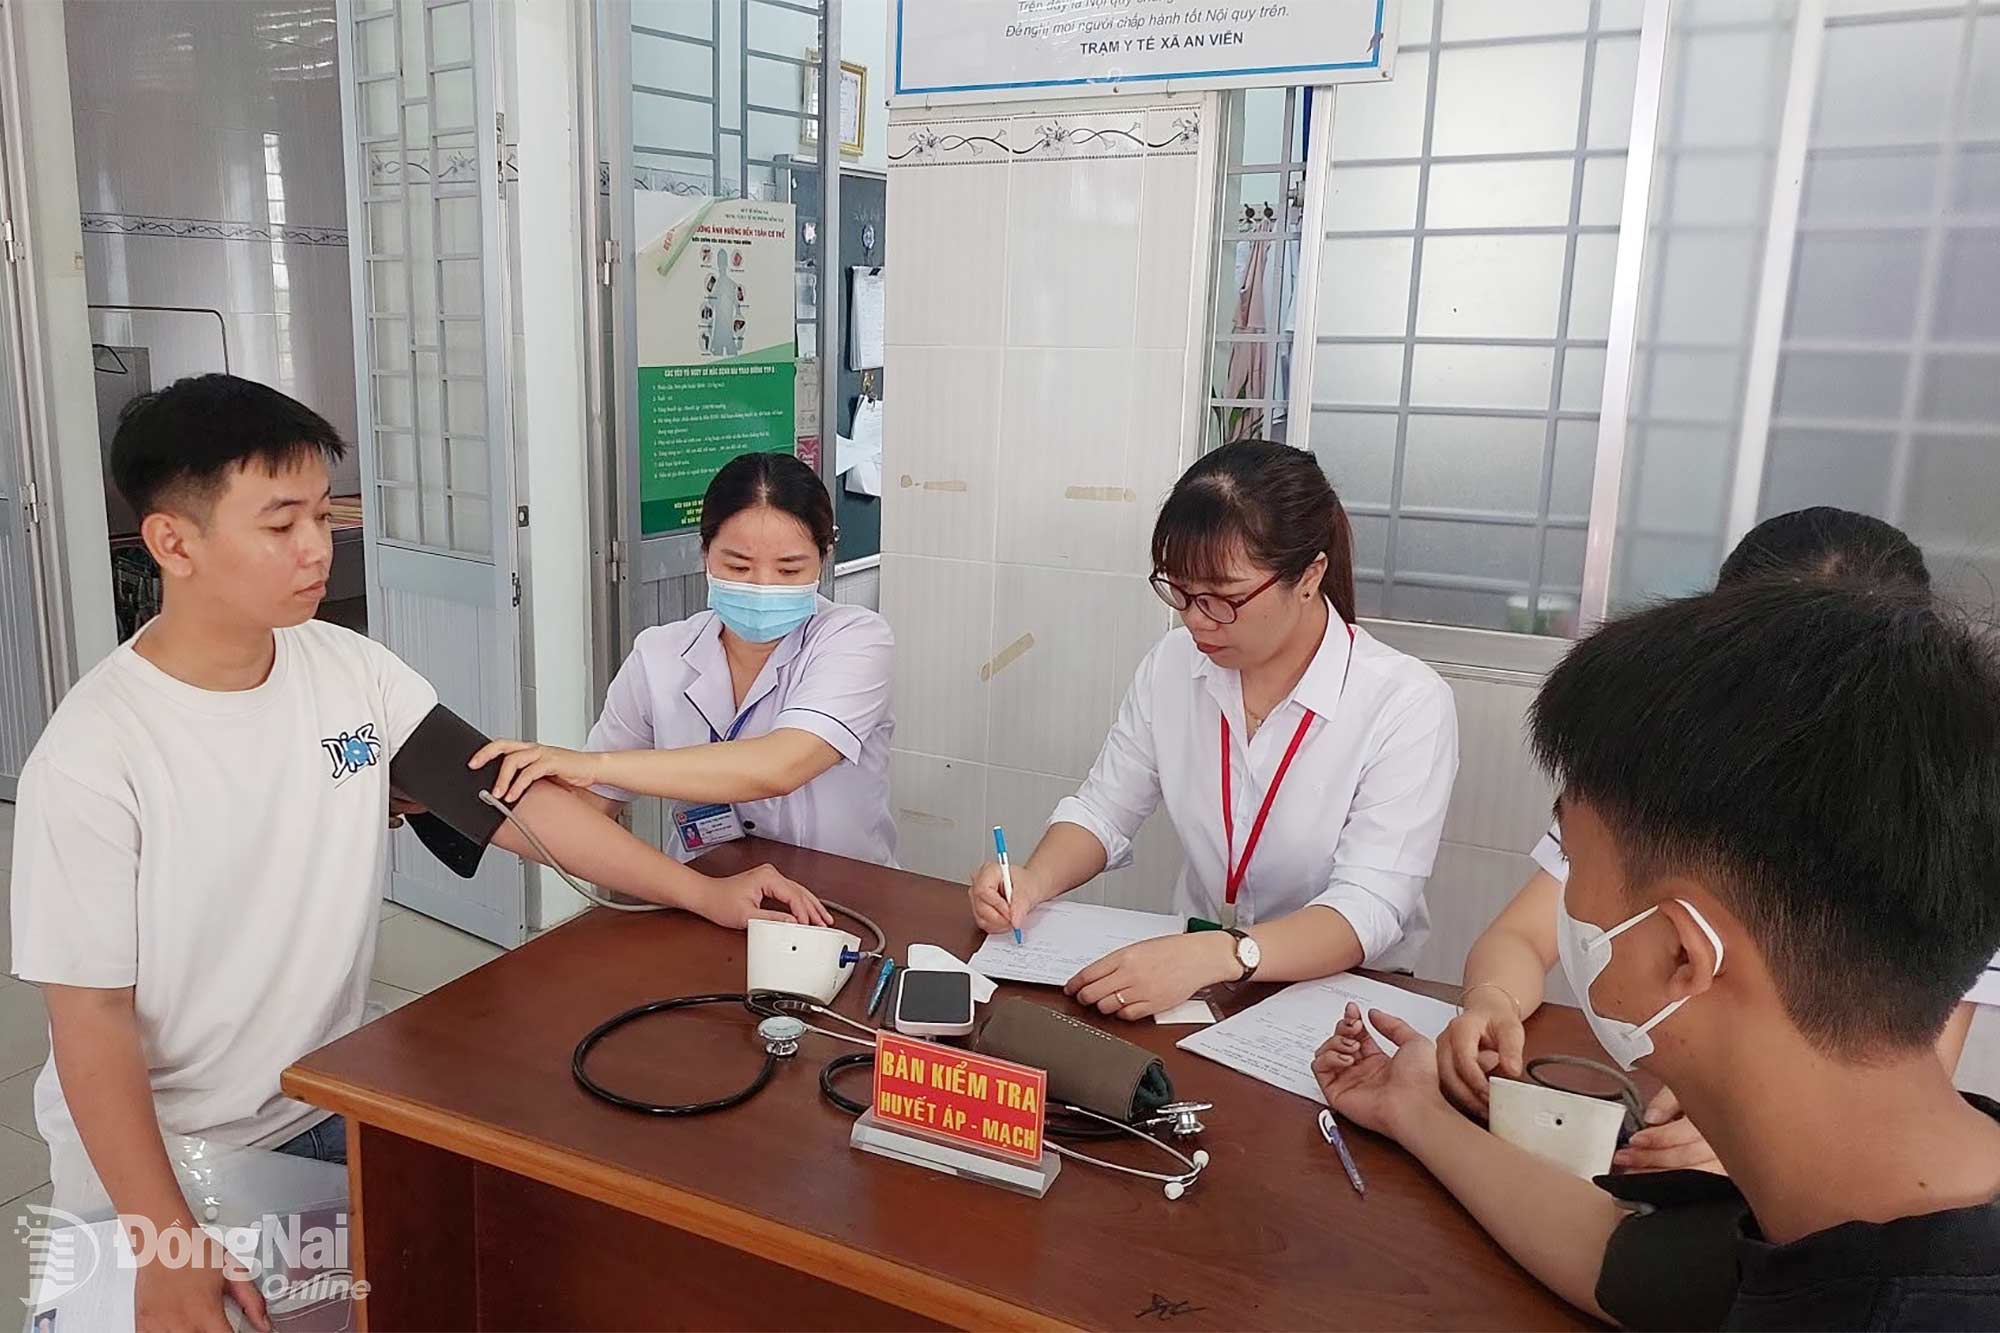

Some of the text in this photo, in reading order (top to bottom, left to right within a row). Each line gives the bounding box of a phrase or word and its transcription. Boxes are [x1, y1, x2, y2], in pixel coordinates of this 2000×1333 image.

[1148, 12, 1181, 26] hành
[1184, 8, 1202, 24] tốt
[1206, 8, 1229, 24] Nội
[1231, 9, 1256, 23] quy
[1259, 4, 1289, 18] trên.
[1080, 41, 1120, 56] TRẠM
[1123, 40, 1133, 52] Y
[1160, 34, 1180, 50] XÃ
[1184, 34, 1204, 47] AN
[881, 1050, 1037, 1114] BÀN KIỂM TRA
[880, 1091, 937, 1124] HUYẾT
[942, 1104, 967, 1131] ÁP
[982, 1118, 1036, 1151] MẠCH
